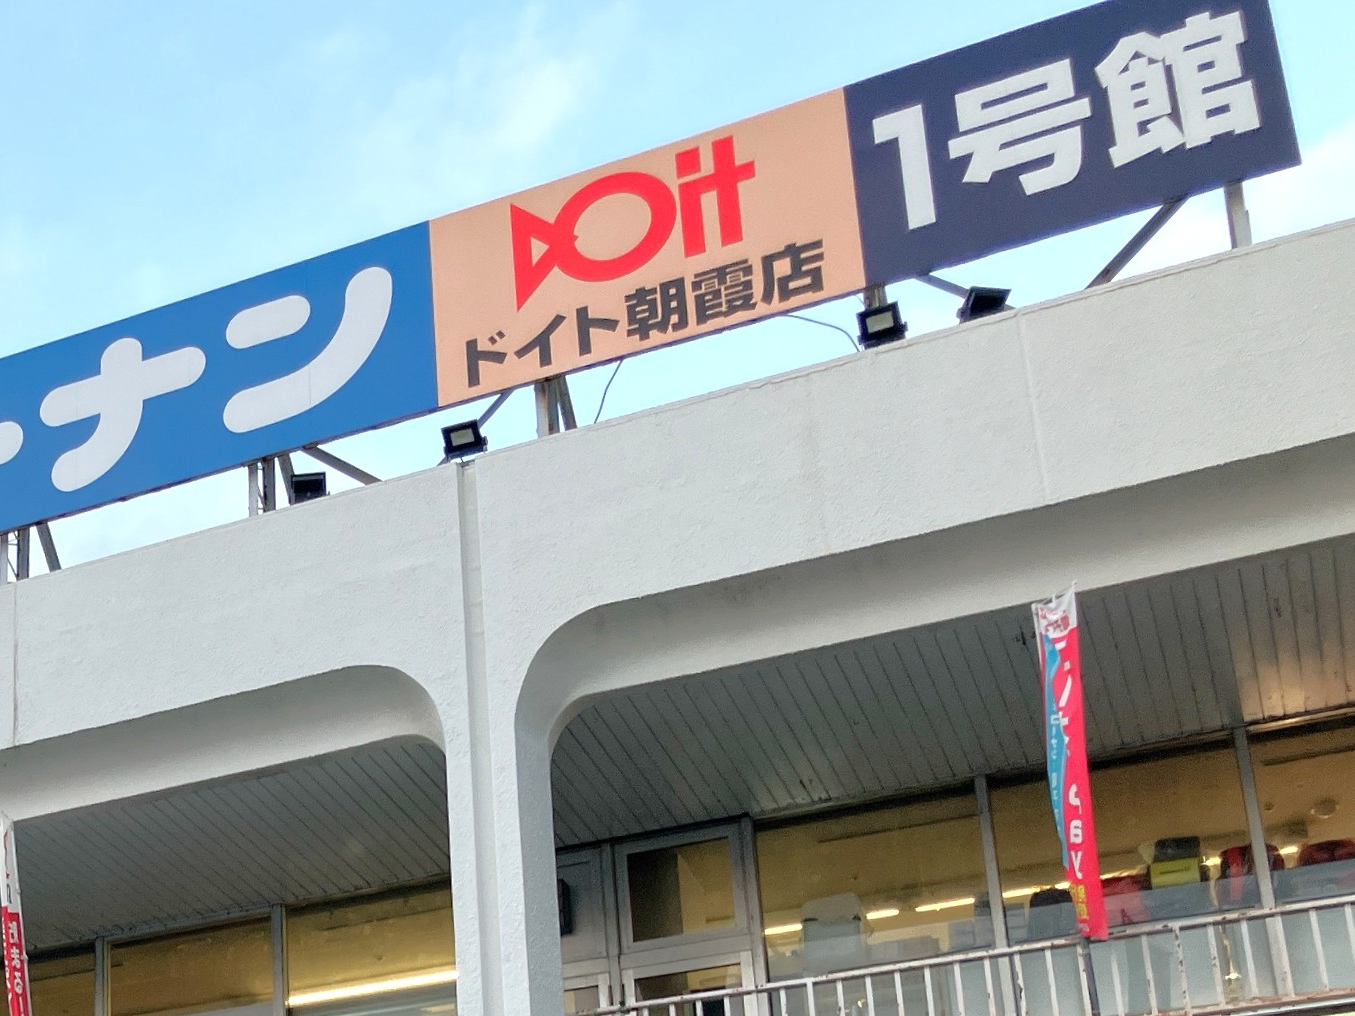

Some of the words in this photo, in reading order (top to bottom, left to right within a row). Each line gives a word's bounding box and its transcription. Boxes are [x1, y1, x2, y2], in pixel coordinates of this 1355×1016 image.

[872, 9, 1260, 230] 1号館
[466, 240, 825, 386] ドイト朝霞店
